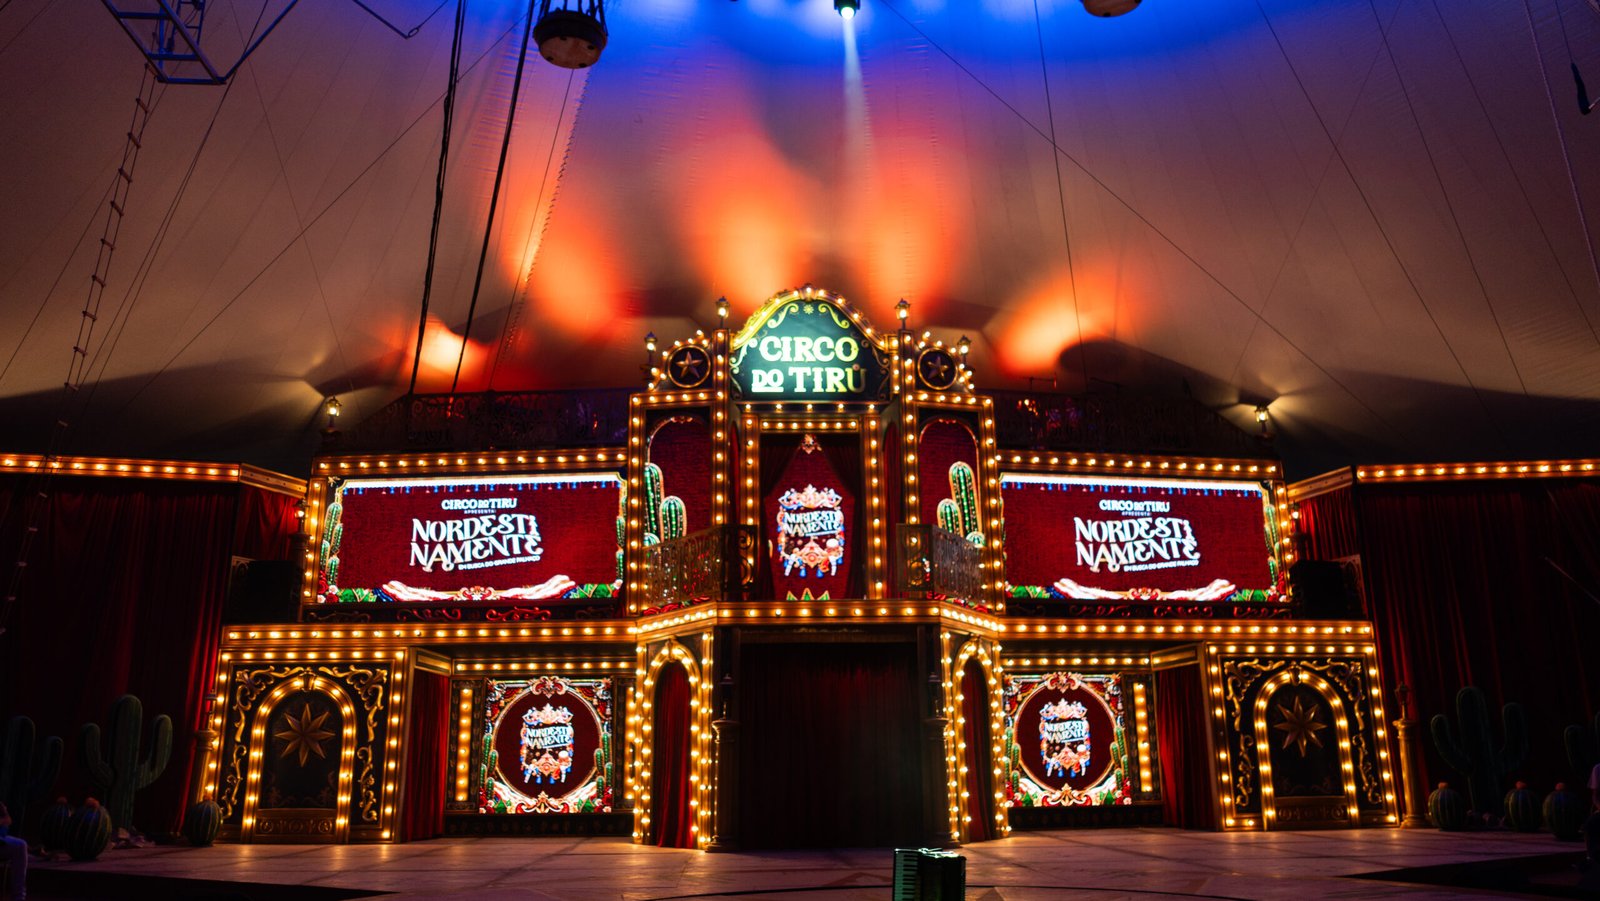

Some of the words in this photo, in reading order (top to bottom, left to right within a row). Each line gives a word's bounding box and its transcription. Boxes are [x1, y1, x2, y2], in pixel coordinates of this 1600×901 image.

[759, 336, 859, 362] CIRCO
[751, 368, 784, 393] DO
[441, 498, 478, 510] CIRCO
[1098, 499, 1133, 511] CIRCO
[412, 513, 540, 543] NORDESTI
[1073, 516, 1195, 543] NORDESTI
[409, 534, 544, 572] NAMENTE
[1075, 537, 1201, 573] NAMENTE
